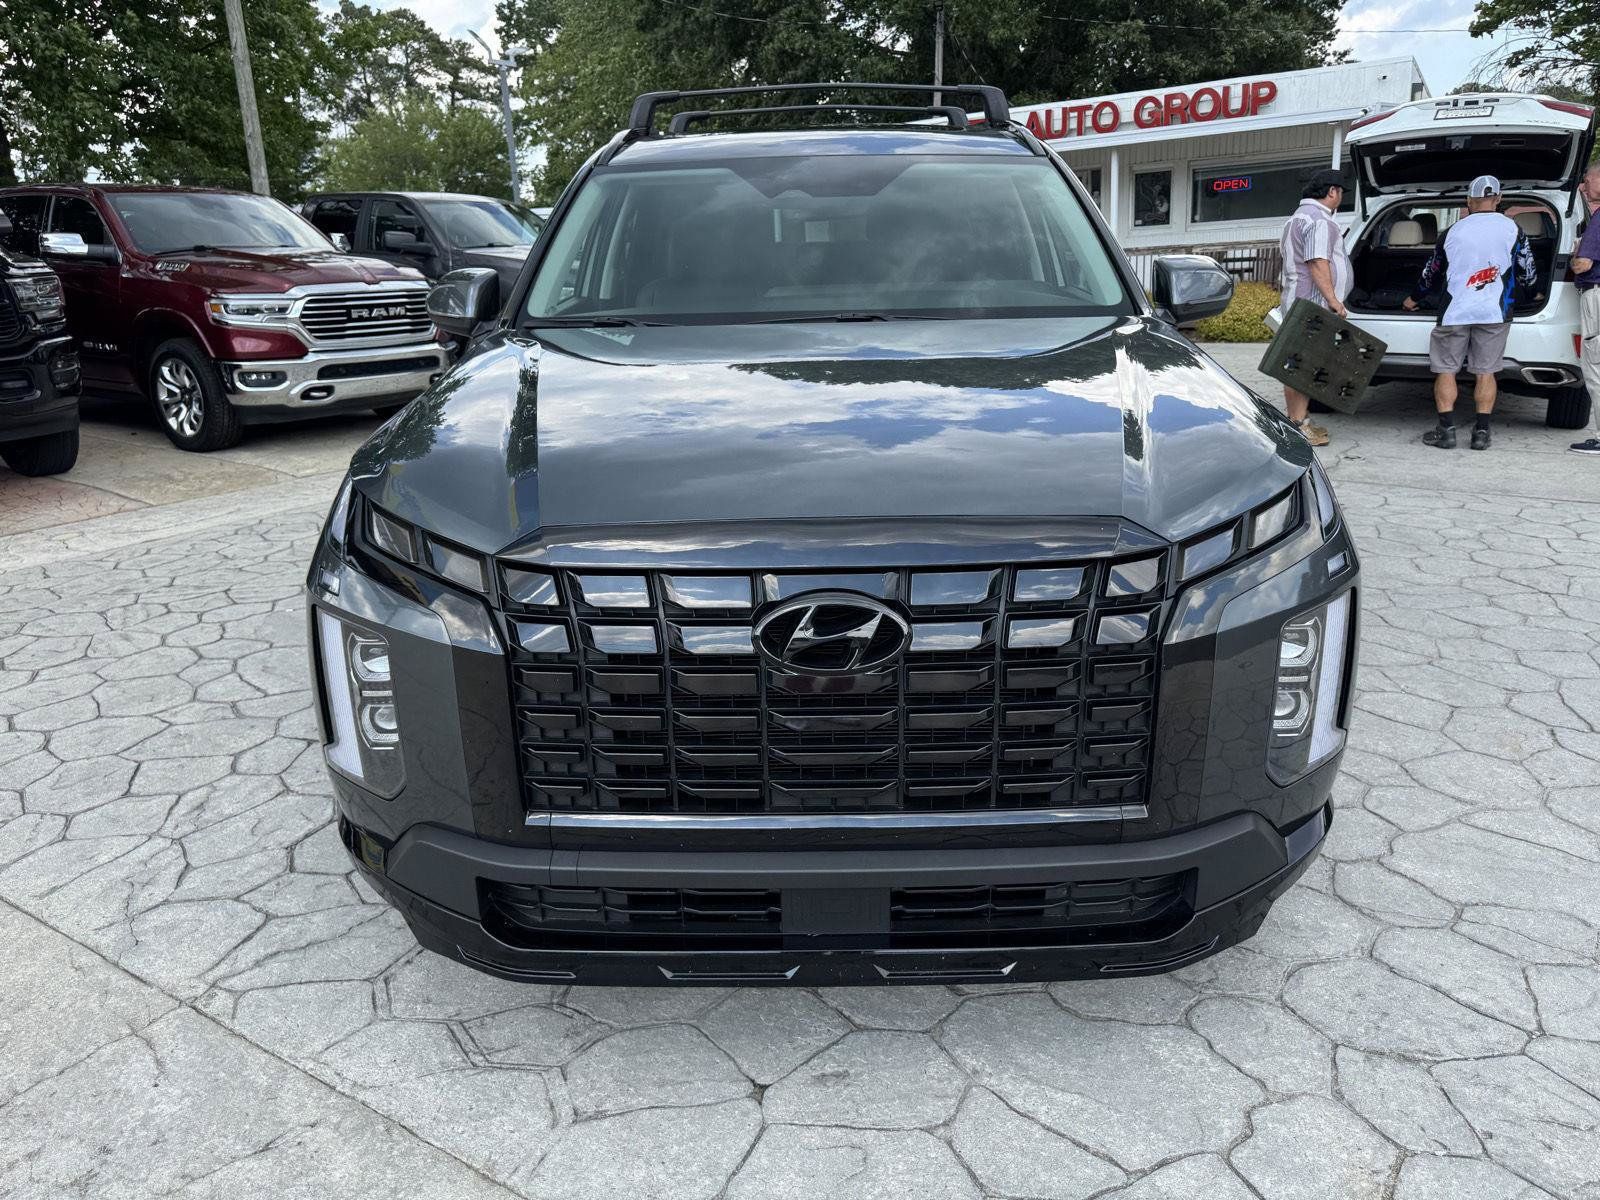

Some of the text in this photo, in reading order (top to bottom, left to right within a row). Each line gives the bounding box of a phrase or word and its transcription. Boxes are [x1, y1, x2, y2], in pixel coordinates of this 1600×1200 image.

[1025, 81, 1277, 140] AUTO GROUP
[1213, 179, 1249, 191] OPEN
[351, 306, 406, 319] RAM
